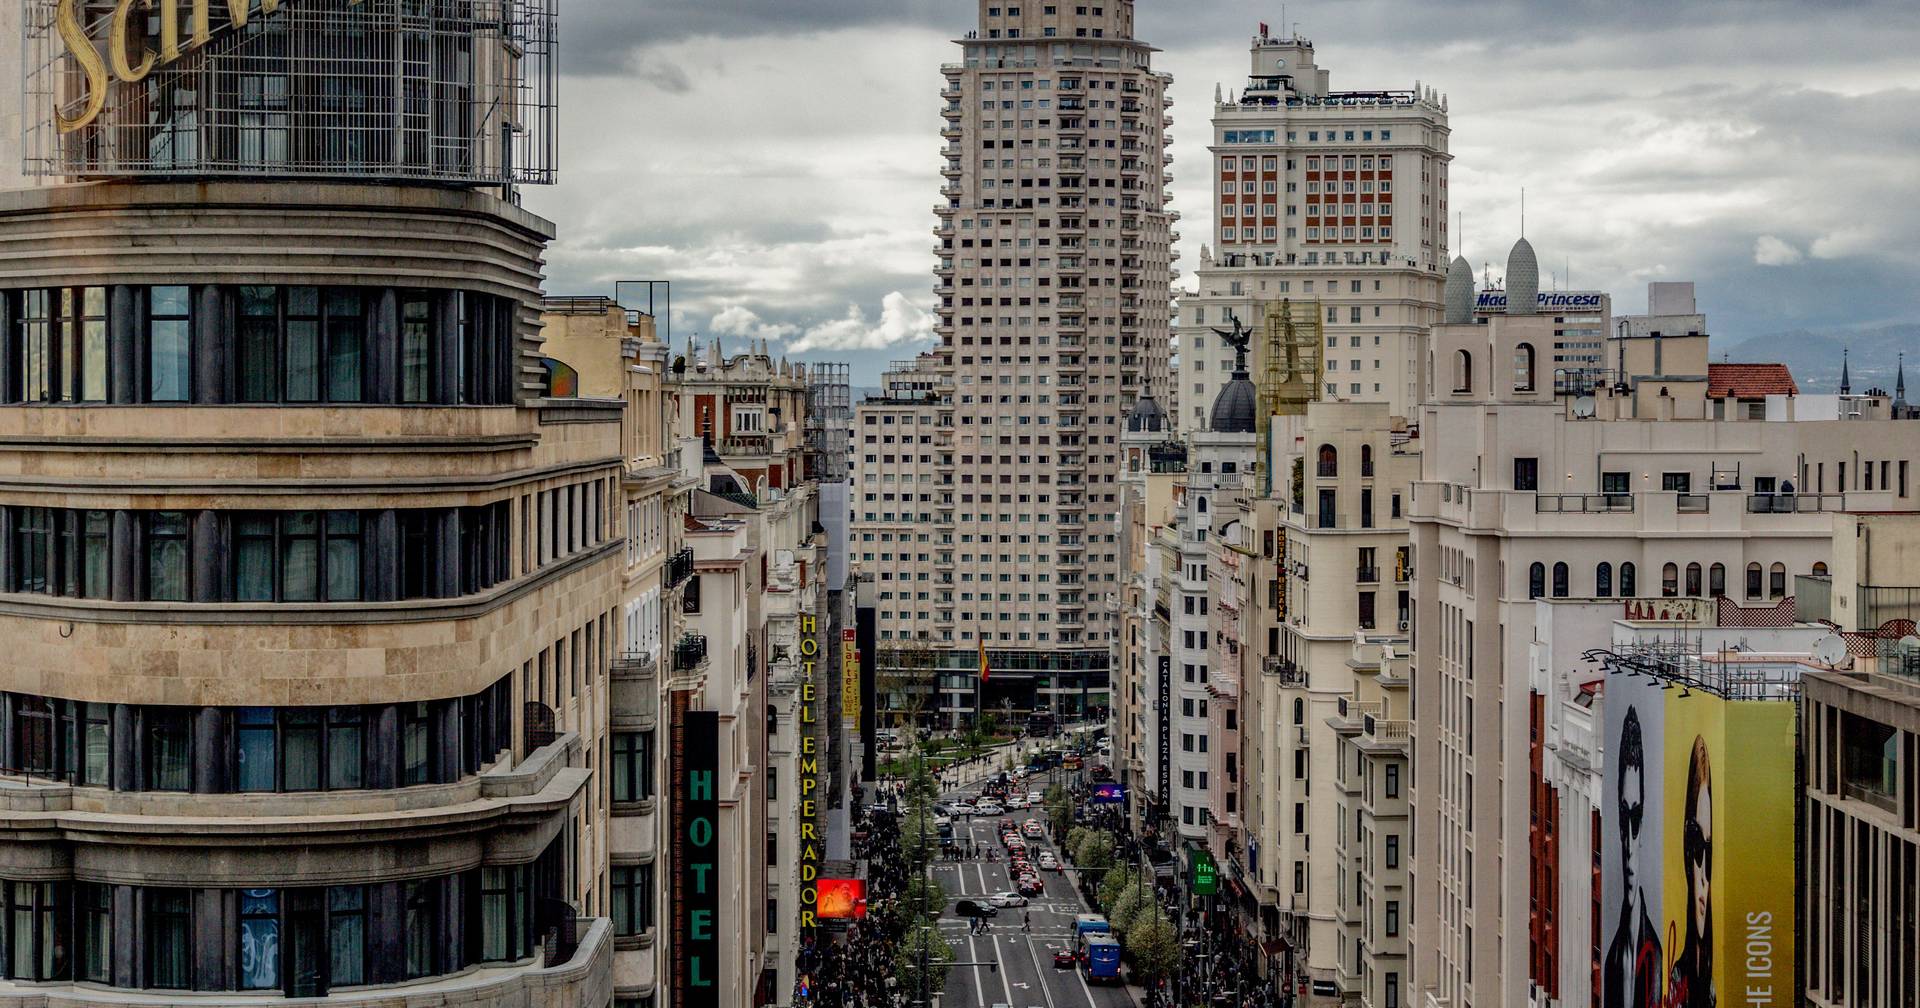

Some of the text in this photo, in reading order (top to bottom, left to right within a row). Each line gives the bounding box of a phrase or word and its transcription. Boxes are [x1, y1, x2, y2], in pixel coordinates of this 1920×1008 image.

[1537, 293, 1600, 305] Princesa
[801, 616, 817, 927] HOTEL EMPERADOR
[689, 770, 712, 986] HOTEL
[1746, 911, 1772, 978] ICONS
